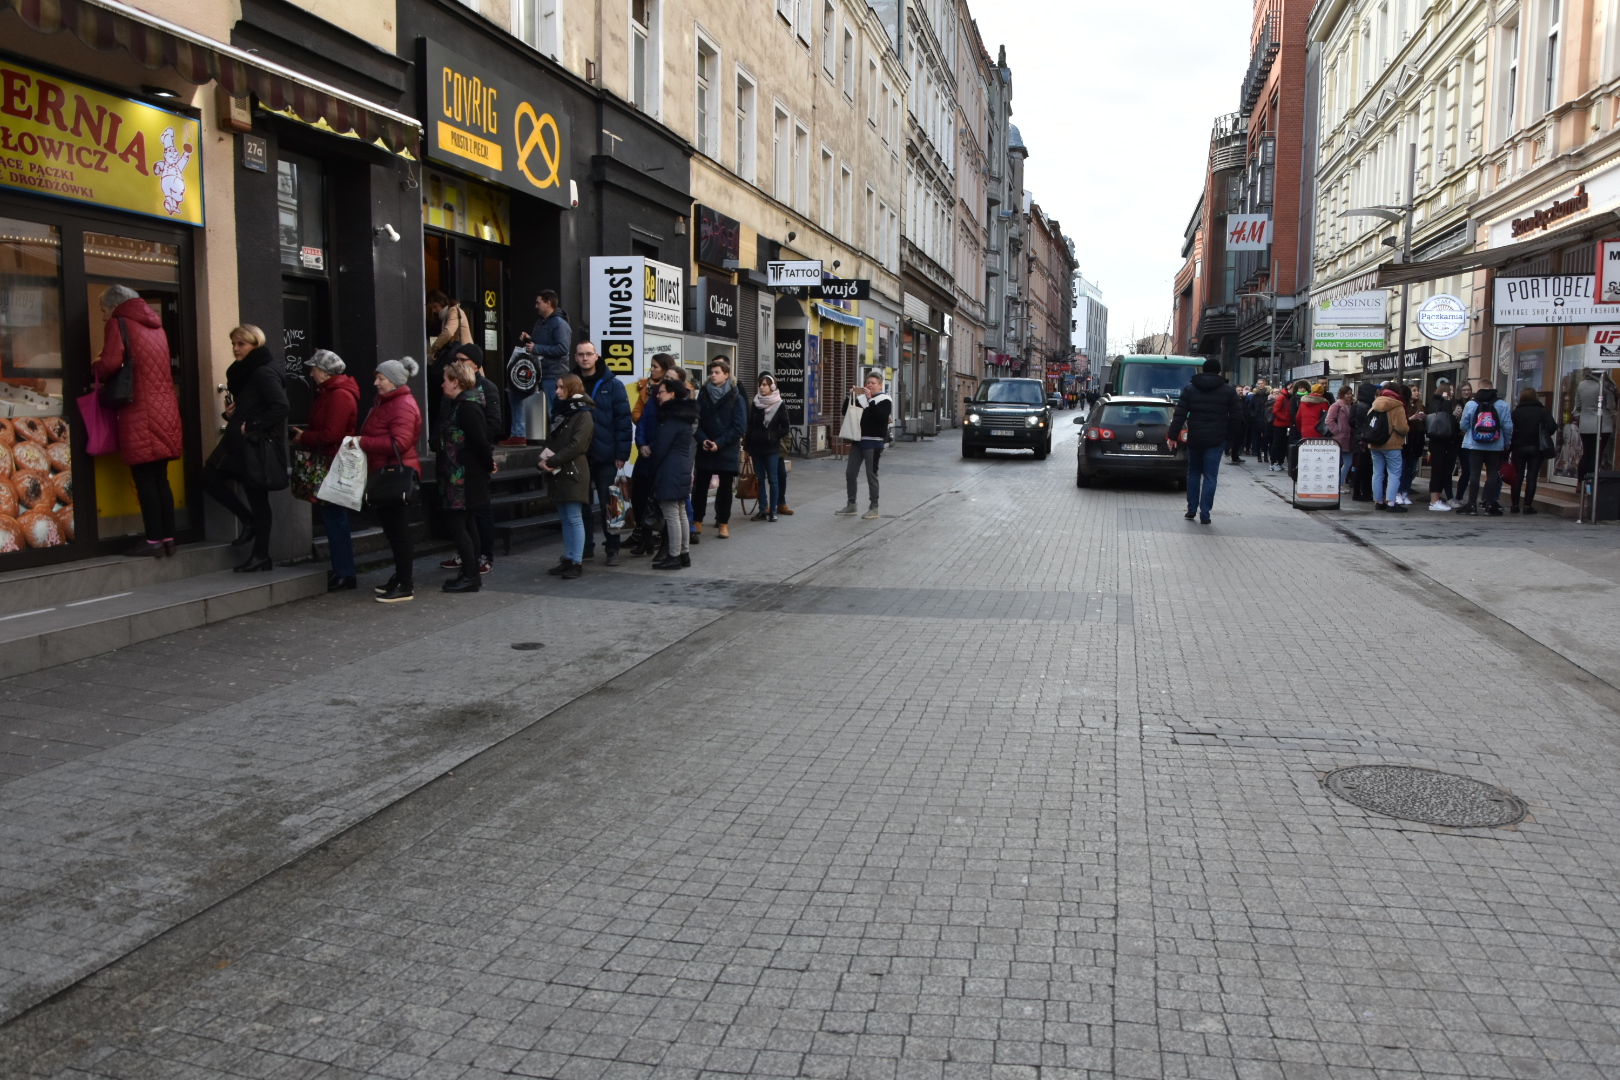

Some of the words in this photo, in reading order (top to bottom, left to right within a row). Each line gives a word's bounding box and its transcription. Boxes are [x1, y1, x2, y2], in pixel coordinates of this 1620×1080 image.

[443, 66, 498, 135] COVRIG
[0, 126, 110, 174] ŁOWICZ
[247, 141, 263, 157] 27a
[29, 162, 75, 181] PĄCZKI
[9, 172, 95, 198] DROŻDŻÓWKI
[1230, 220, 1266, 244] H&M
[785, 268, 820, 278] TATTOO
[645, 266, 656, 301] Be
[657, 270, 680, 306] invest
[1507, 276, 1595, 303] PORTOBEL
[602, 265, 633, 336] invest
[709, 294, 733, 318] Chérie
[1332, 298, 1381, 307] COSINUS
[1561, 307, 1586, 315] STREET
[1590, 306, 1620, 314] FASHION
[1421, 312, 1463, 321] Pączkarnia
[1545, 315, 1574, 323] KOMIS
[605, 343, 633, 372] Be
[1379, 356, 1393, 370] SALON
[774, 368, 804, 376] LIQUIDY
